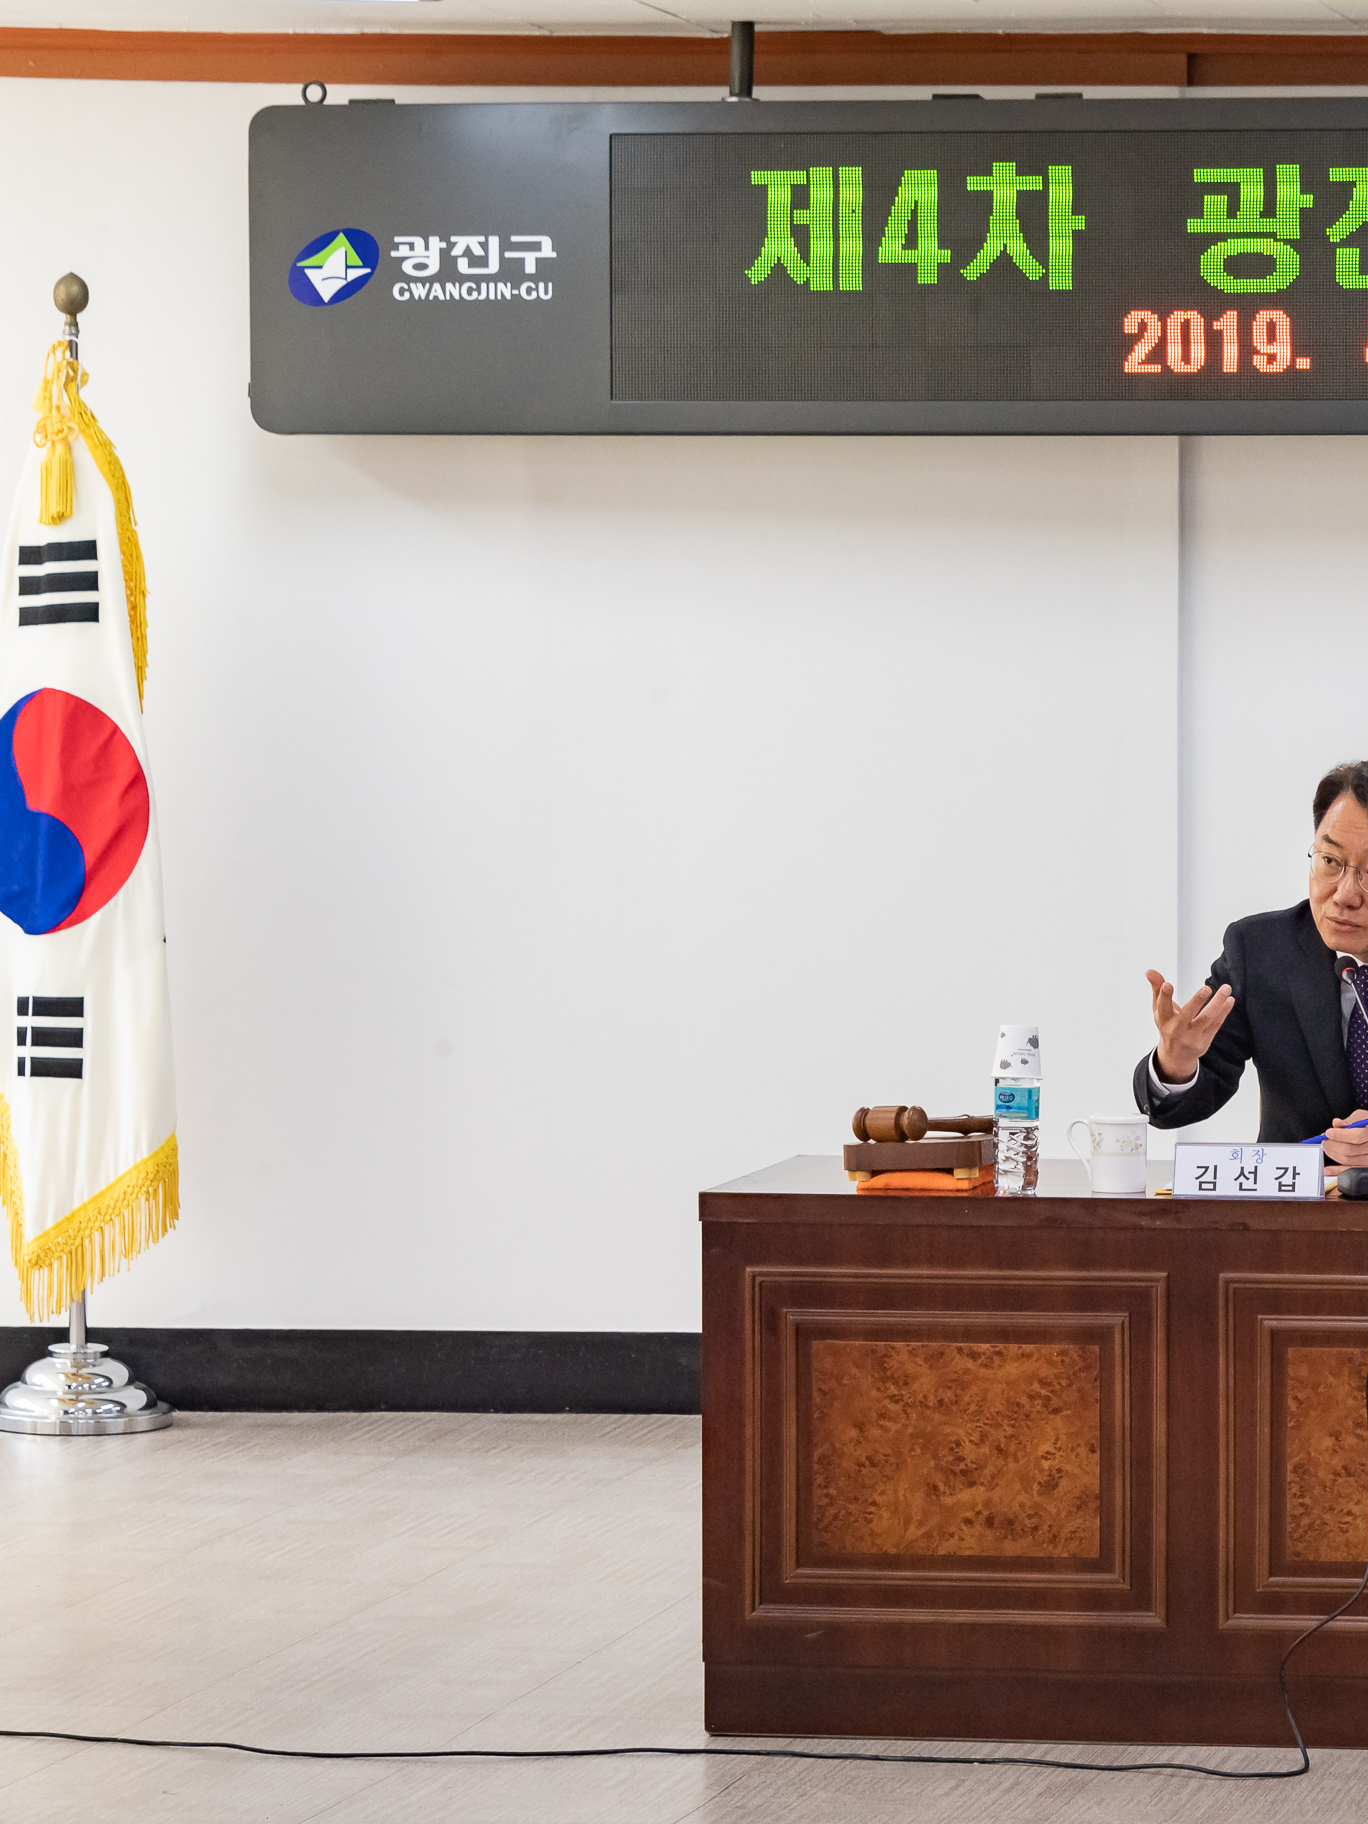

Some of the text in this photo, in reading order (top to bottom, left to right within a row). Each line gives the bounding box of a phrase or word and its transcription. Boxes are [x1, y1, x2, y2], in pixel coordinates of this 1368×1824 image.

[744, 162, 1086, 292] 제4차
[390, 234, 558, 278] 광진구
[391, 281, 553, 302] GWANGJIN-GU
[1122, 308, 1313, 376] 2019.
